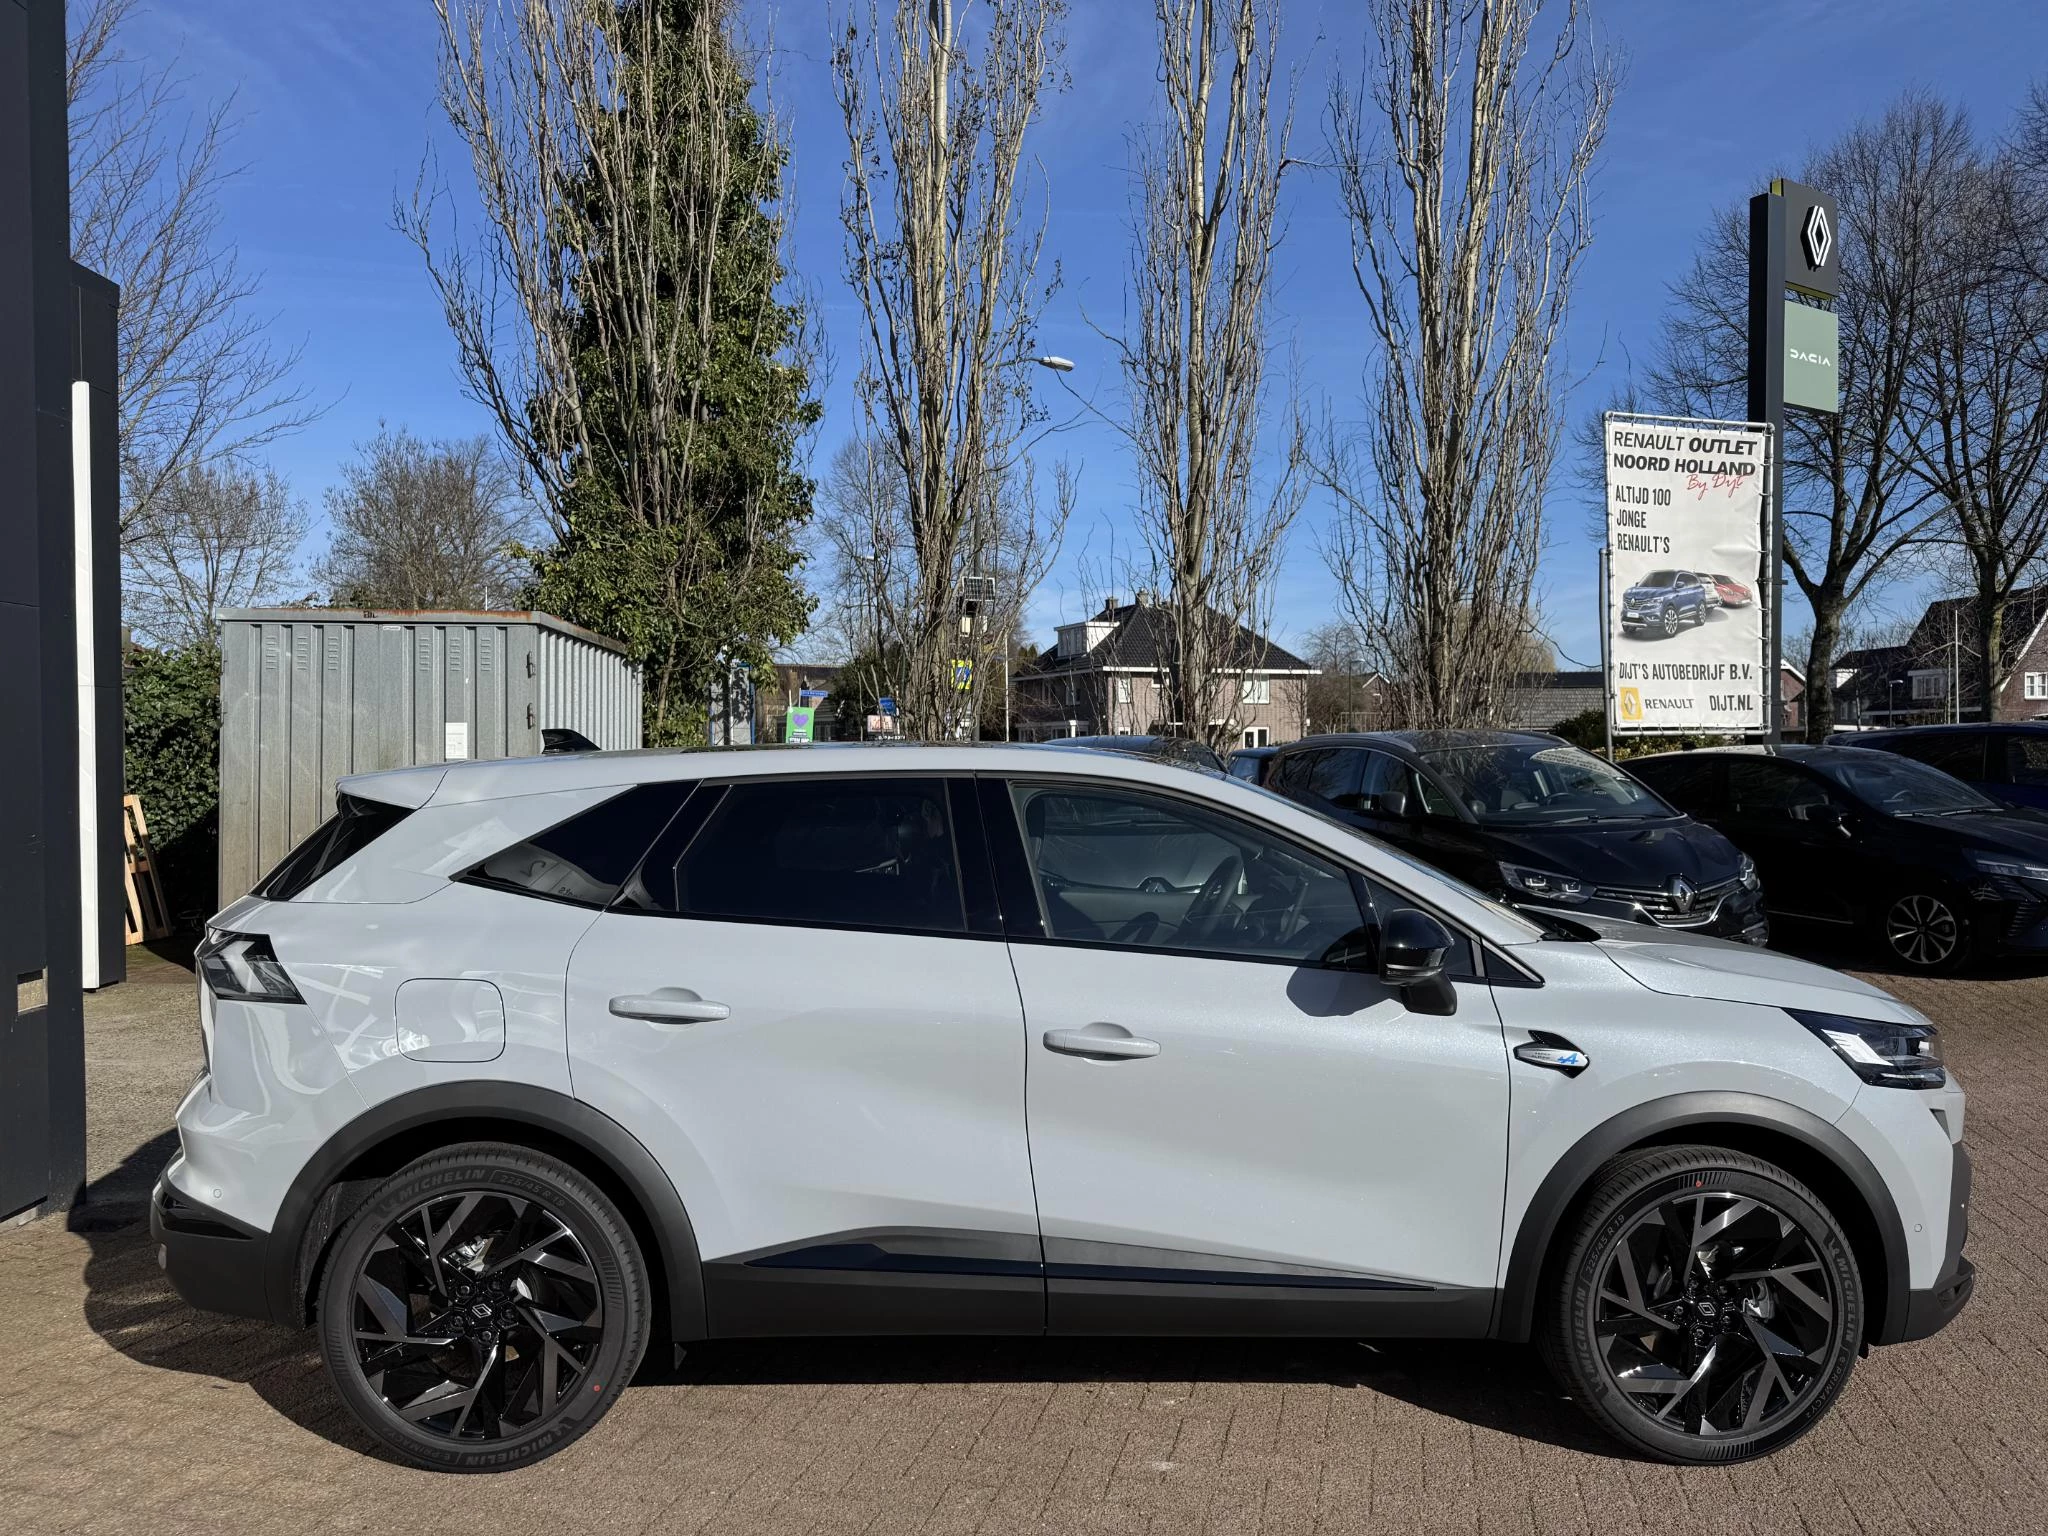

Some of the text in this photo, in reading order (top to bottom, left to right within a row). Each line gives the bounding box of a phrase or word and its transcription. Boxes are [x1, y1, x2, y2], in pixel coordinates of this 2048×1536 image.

[1789, 348, 1831, 367] DACIA
[1614, 431, 1758, 455] RENAULT OUTLET
[1613, 453, 1756, 476] NOORD HOLLAND
[1615, 484, 1671, 506] ALTIJD 100
[1686, 473, 1708, 500] By
[1616, 508, 1647, 528] JONGE
[1617, 532, 1670, 554] RENAULT'S
[1619, 662, 1753, 681] DIJT'S AUTOBEDRIJF B.V.
[1644, 698, 1695, 710] RENAULT
[1709, 694, 1754, 711] DIJT.NL
[399, 1168, 486, 1201] MICHELIN
[1586, 1214, 1625, 1273] 225/45 R 19
[1837, 1257, 1856, 1343] MICHELIN
[1574, 1286, 1595, 1373] MICHELIN
[465, 1433, 553, 1466] MICHELIN
